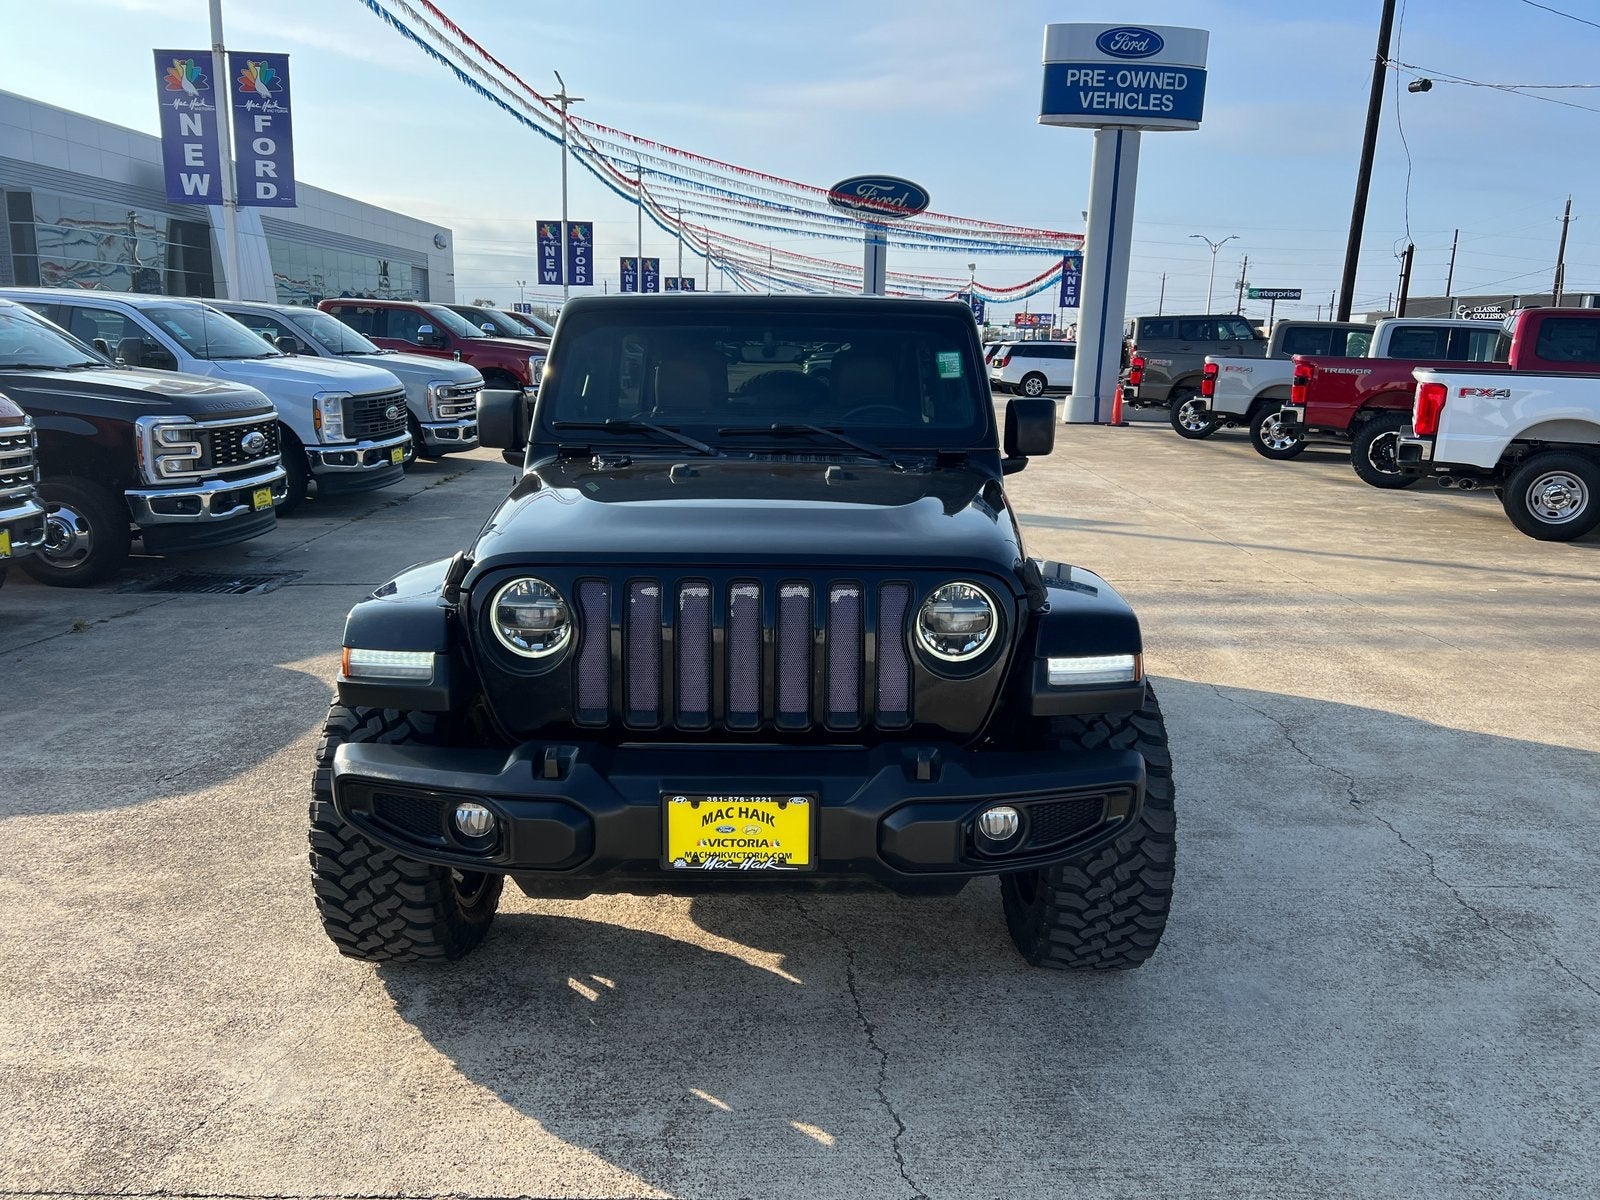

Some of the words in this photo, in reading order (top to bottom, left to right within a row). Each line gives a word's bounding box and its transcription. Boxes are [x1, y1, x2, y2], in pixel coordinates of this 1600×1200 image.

[1110, 31, 1150, 52] Ford
[1079, 91, 1174, 112] VEHICLES
[179, 112, 210, 196] NEW
[252, 114, 278, 199] FORD
[543, 246, 558, 282] NEW
[575, 248, 587, 284] FORD
[625, 275, 634, 292] NE
[1064, 276, 1077, 306] NEW
[1249, 290, 1301, 298] enterprise
[1323, 367, 1372, 375] TREMOR
[1459, 387, 1511, 399] FX4
[701, 807, 735, 828] MAC
[738, 807, 776, 828] HAIK
[708, 838, 770, 848] VICTORIA
[701, 856, 732, 871] Mac
[739, 856, 777, 871] Haik
